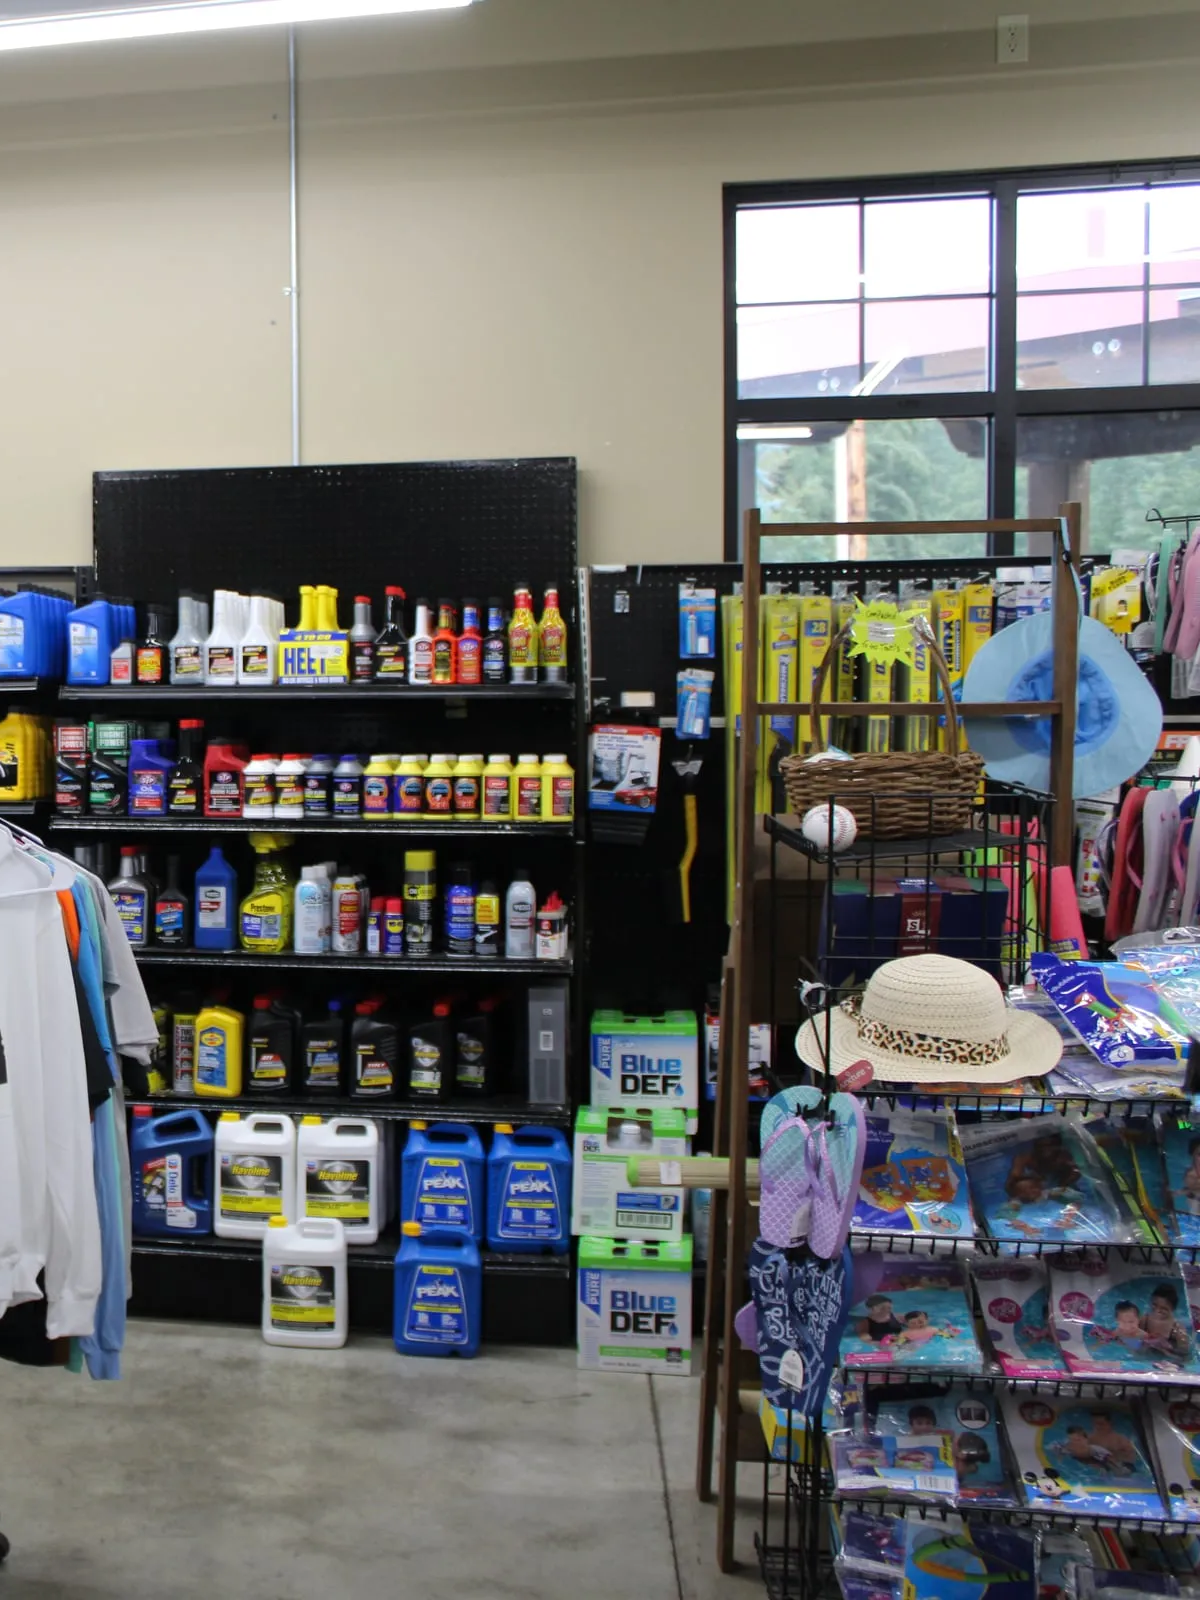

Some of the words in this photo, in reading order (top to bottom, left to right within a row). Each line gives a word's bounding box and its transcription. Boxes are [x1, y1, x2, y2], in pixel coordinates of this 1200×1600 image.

[601, 1038, 612, 1069] PURE
[621, 1054, 682, 1074] Blue
[621, 1074, 682, 1095] DEF
[232, 1165, 271, 1177] Havoline
[318, 1170, 359, 1182] Havoline
[168, 1172, 179, 1194] Delo
[423, 1175, 465, 1191] PEAK
[510, 1179, 553, 1195] PEAK
[282, 1275, 323, 1287] Havoline
[590, 1271, 600, 1305] PURE
[416, 1284, 460, 1299] PEAK
[610, 1290, 676, 1312] Blue
[610, 1311, 677, 1335] DEF
